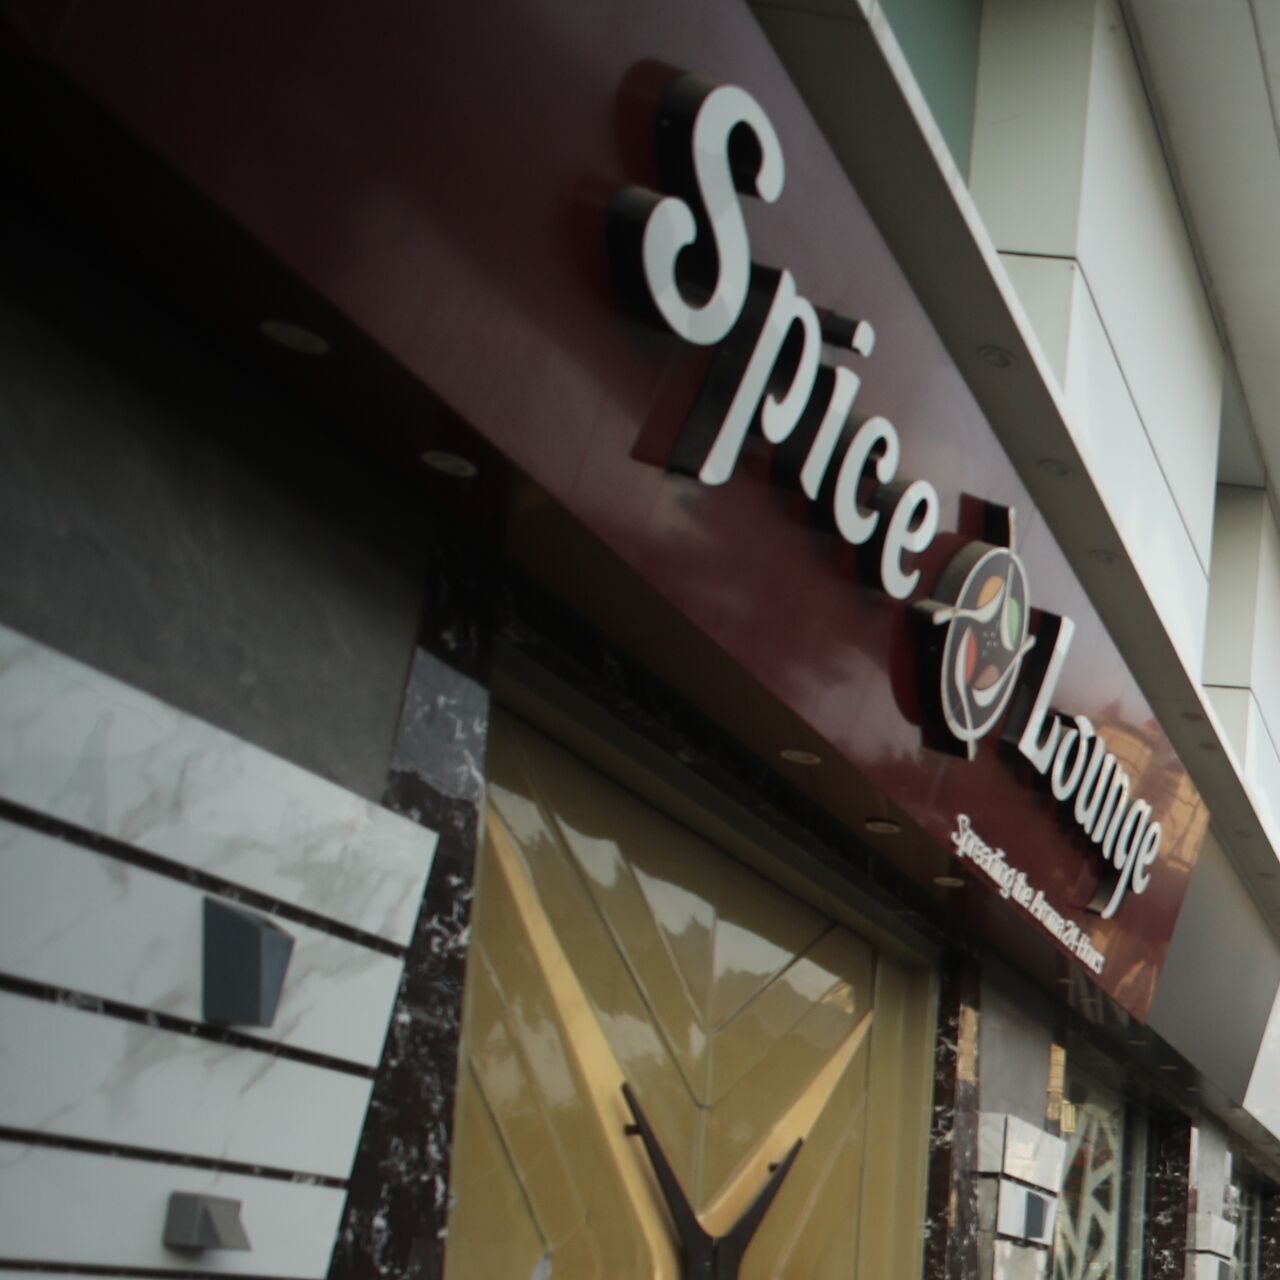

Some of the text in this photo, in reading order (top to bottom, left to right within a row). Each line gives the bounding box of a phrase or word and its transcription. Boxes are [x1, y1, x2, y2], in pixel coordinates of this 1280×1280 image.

[642, 84, 1162, 919] Spice Lounge
[1011, 872, 1034, 908] the
